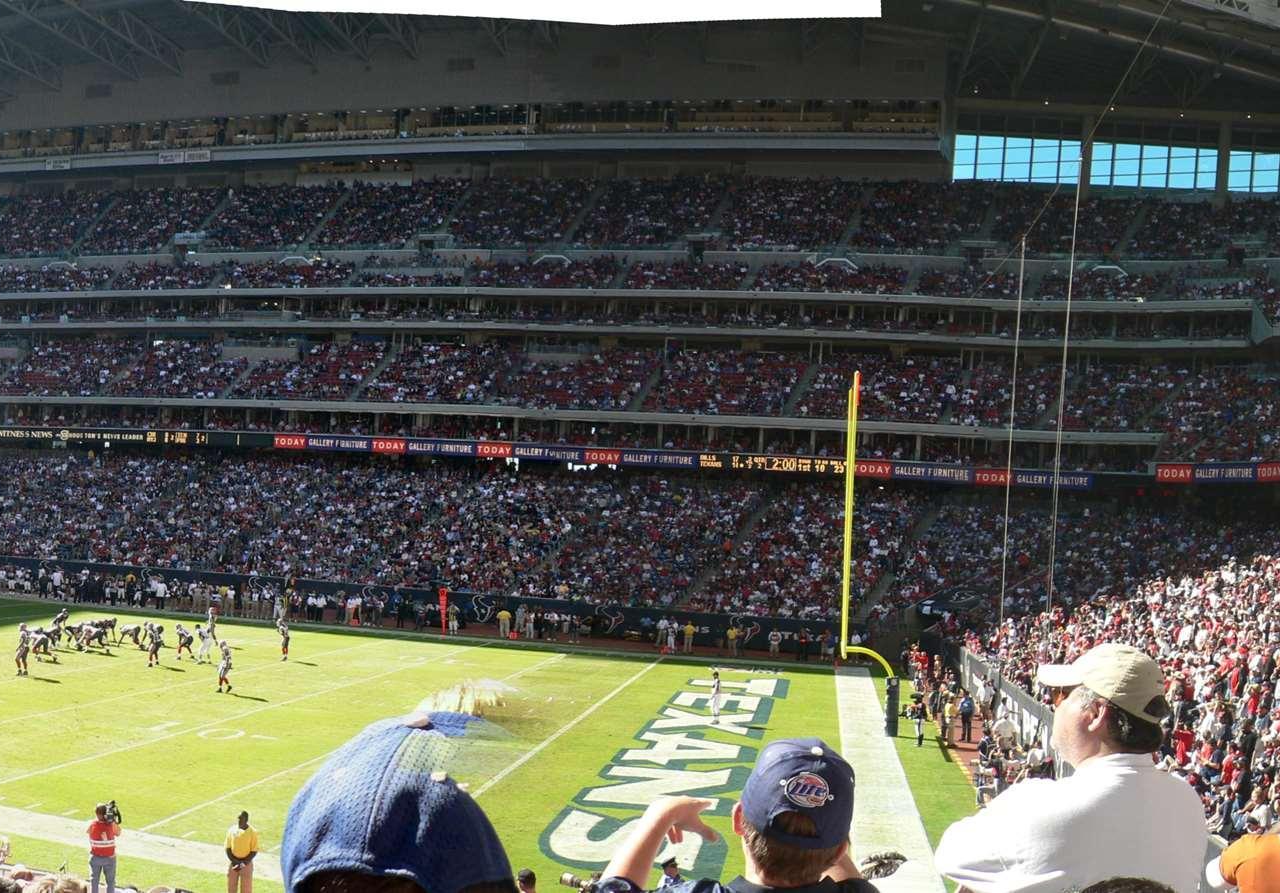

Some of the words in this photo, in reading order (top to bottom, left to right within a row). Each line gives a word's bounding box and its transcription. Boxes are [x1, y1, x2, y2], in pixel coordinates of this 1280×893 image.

[274, 438, 305, 446] TODAY
[308, 439, 333, 448] GALLERY
[373, 441, 405, 450] TODAY
[409, 443, 435, 451] GALLERY
[477, 445, 511, 455] TODAY
[515, 447, 543, 457] GALLERY
[585, 452, 620, 461] TODAY
[623, 453, 652, 463] GALLERY
[654, 455, 693, 465] FURNITURE
[772, 458, 796, 470] 2:00
[798, 464, 811, 472] 1st
[894, 467, 925, 476] GALLERY
[928, 468, 969, 481] FURNITURE
[1157, 468, 1192, 478] TODAY
[1195, 468, 1219, 479] GALLERY
[1257, 466, 1280, 478] TODAY
[976, 473, 1012, 482] TODAY
[1017, 475, 1047, 484] GALLERY
[538, 678, 790, 880] TEXANS
